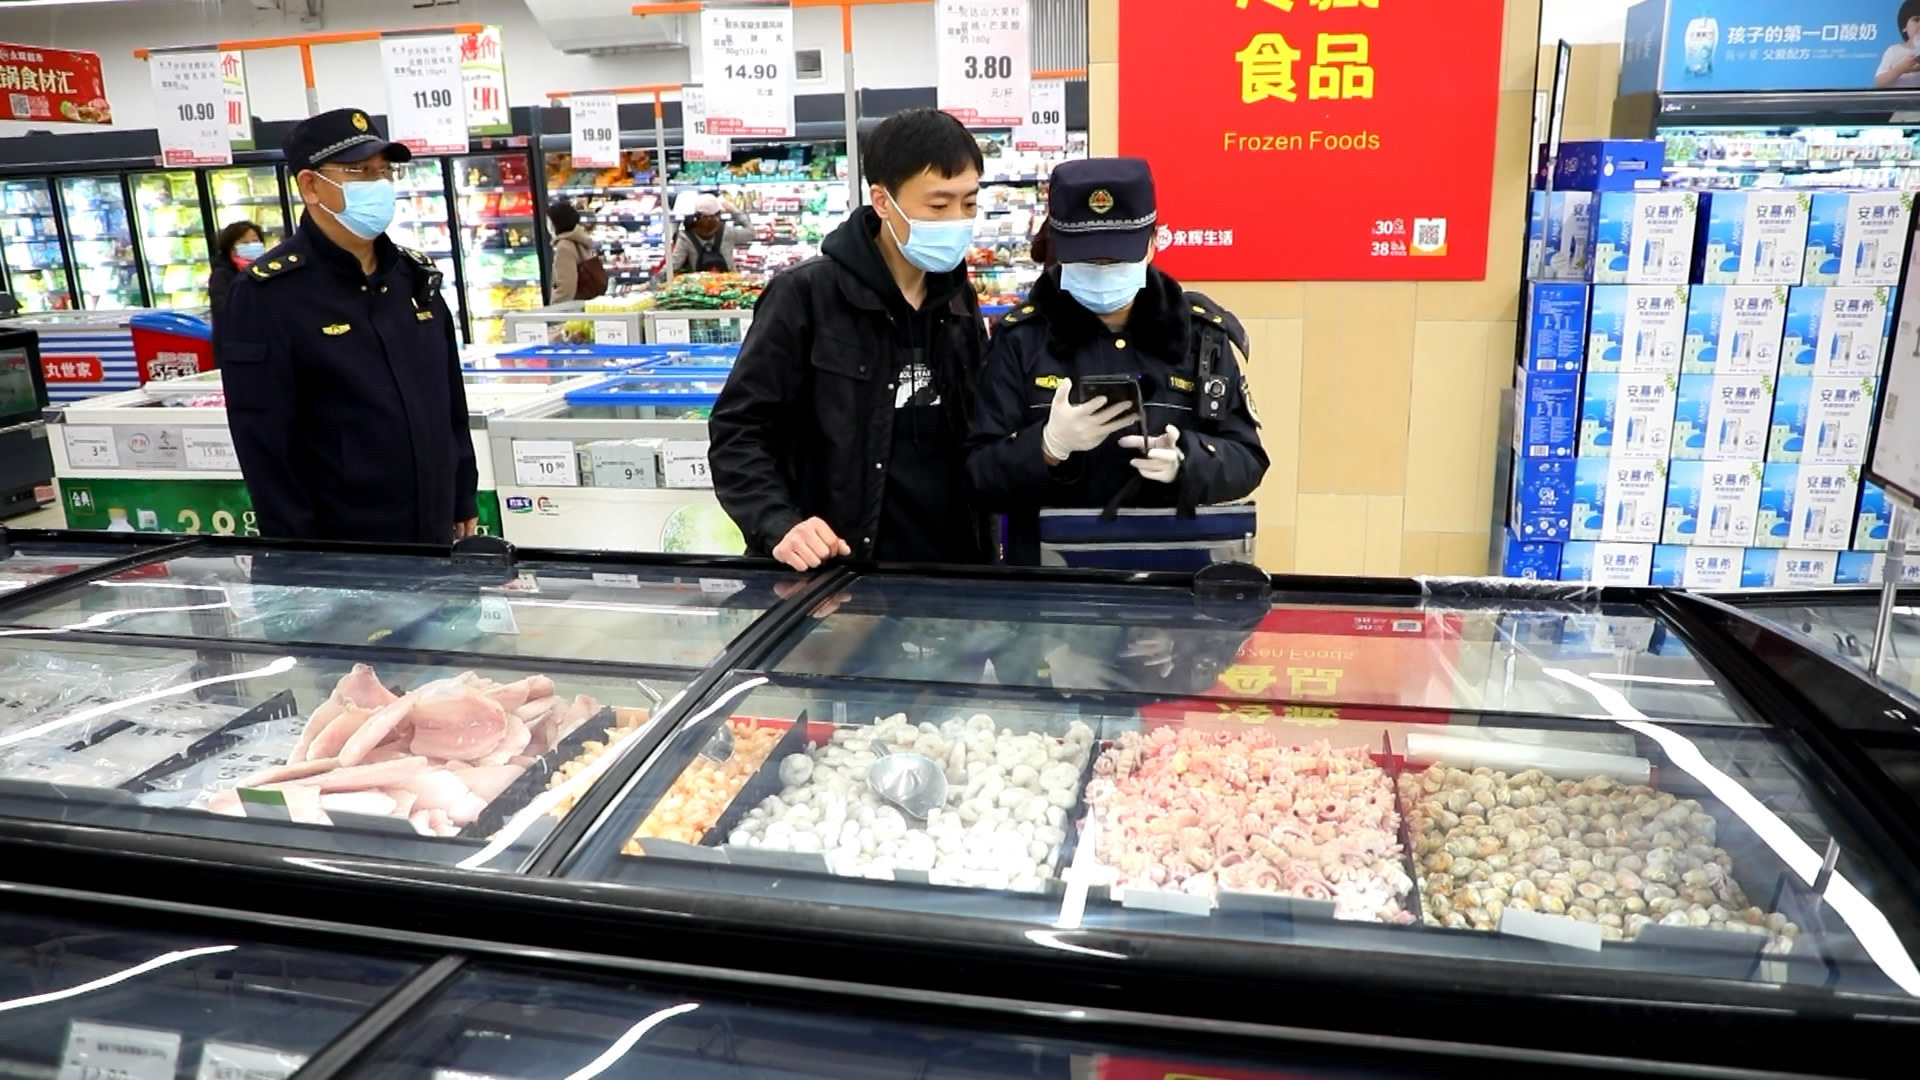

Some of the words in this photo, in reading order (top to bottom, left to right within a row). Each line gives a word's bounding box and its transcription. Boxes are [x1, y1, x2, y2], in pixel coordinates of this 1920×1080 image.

[1727, 23, 1878, 45] 孩子的第一口酸奶
[724, 64, 777, 79] 14.90
[965, 56, 1012, 79] 3.80
[1235, 33, 1374, 104] 食品
[413, 89, 452, 109] 11.90
[177, 103, 215, 121] 10.90
[1032, 111, 1060, 125] 0.90
[583, 128, 612, 141] 19.90
[1224, 132, 1302, 151] Frozen
[1309, 130, 1380, 150] Foods
[1375, 219, 1393, 235] 30
[1173, 229, 1233, 246] 永辉生活
[1370, 240, 1390, 256] 38
[46, 361, 92, 378] 丸世家
